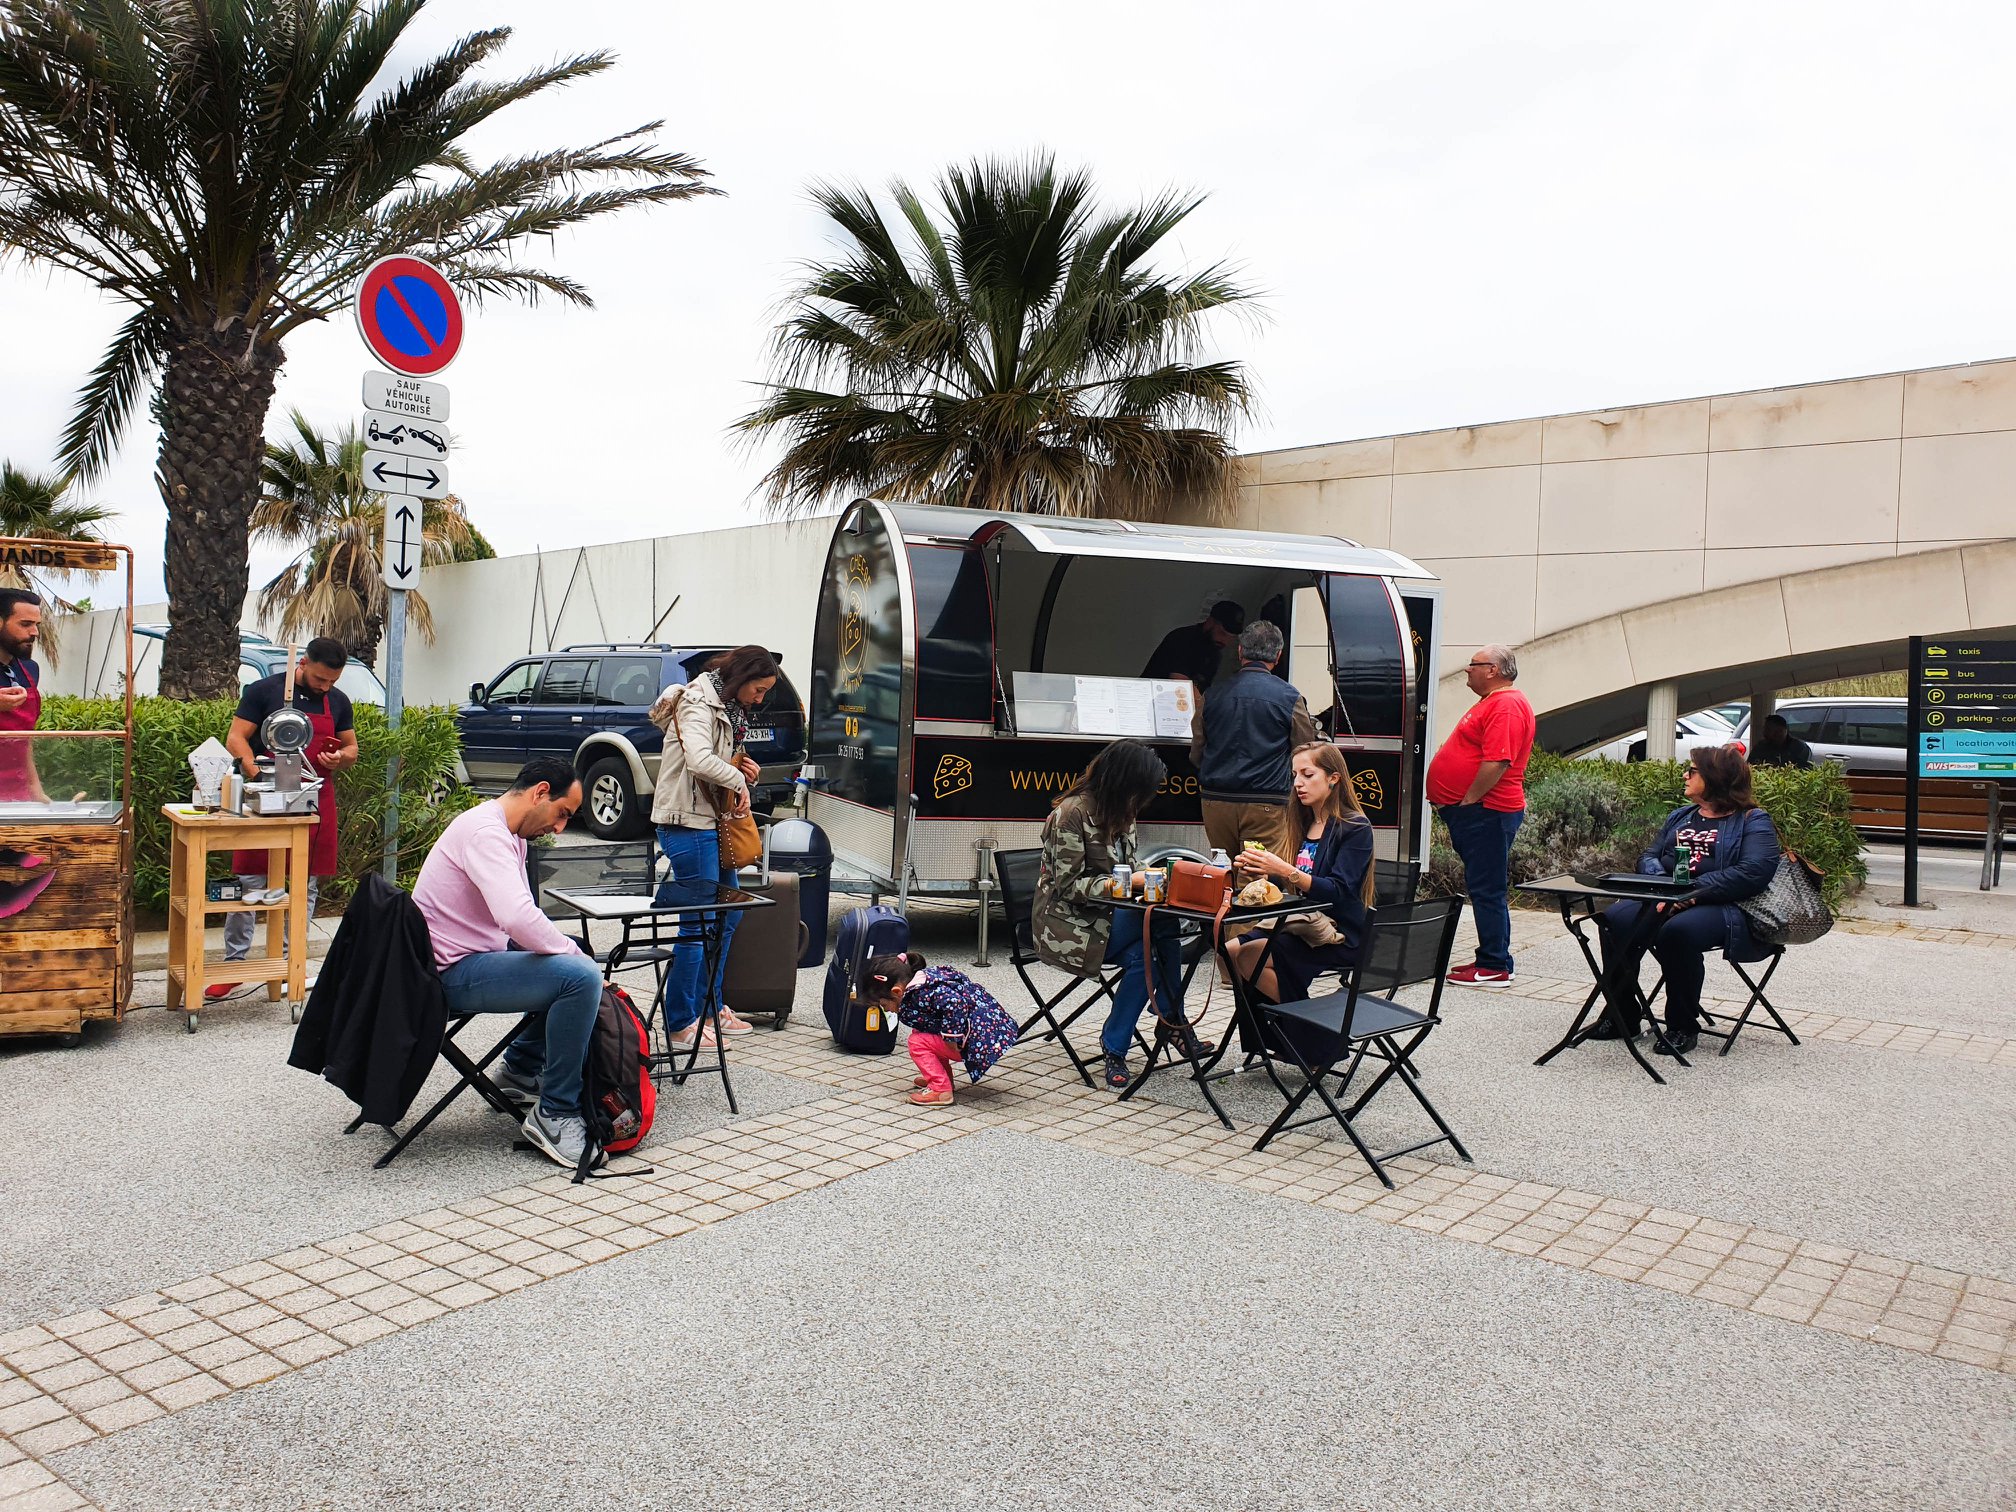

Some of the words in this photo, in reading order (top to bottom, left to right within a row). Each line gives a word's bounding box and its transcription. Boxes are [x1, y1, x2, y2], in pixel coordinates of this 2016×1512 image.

[397, 379, 421, 391] SAUF
[386, 388, 431, 405] VÉHICULE
[385, 399, 431, 415] AUTORISÉ
[1957, 670, 1975, 678] bus
[1957, 692, 1994, 701] parking
[1956, 714, 1993, 724] parking
[1956, 739, 1995, 747] location
[1997, 739, 2016, 747] voit
[1926, 762, 1949, 770] AVIS
